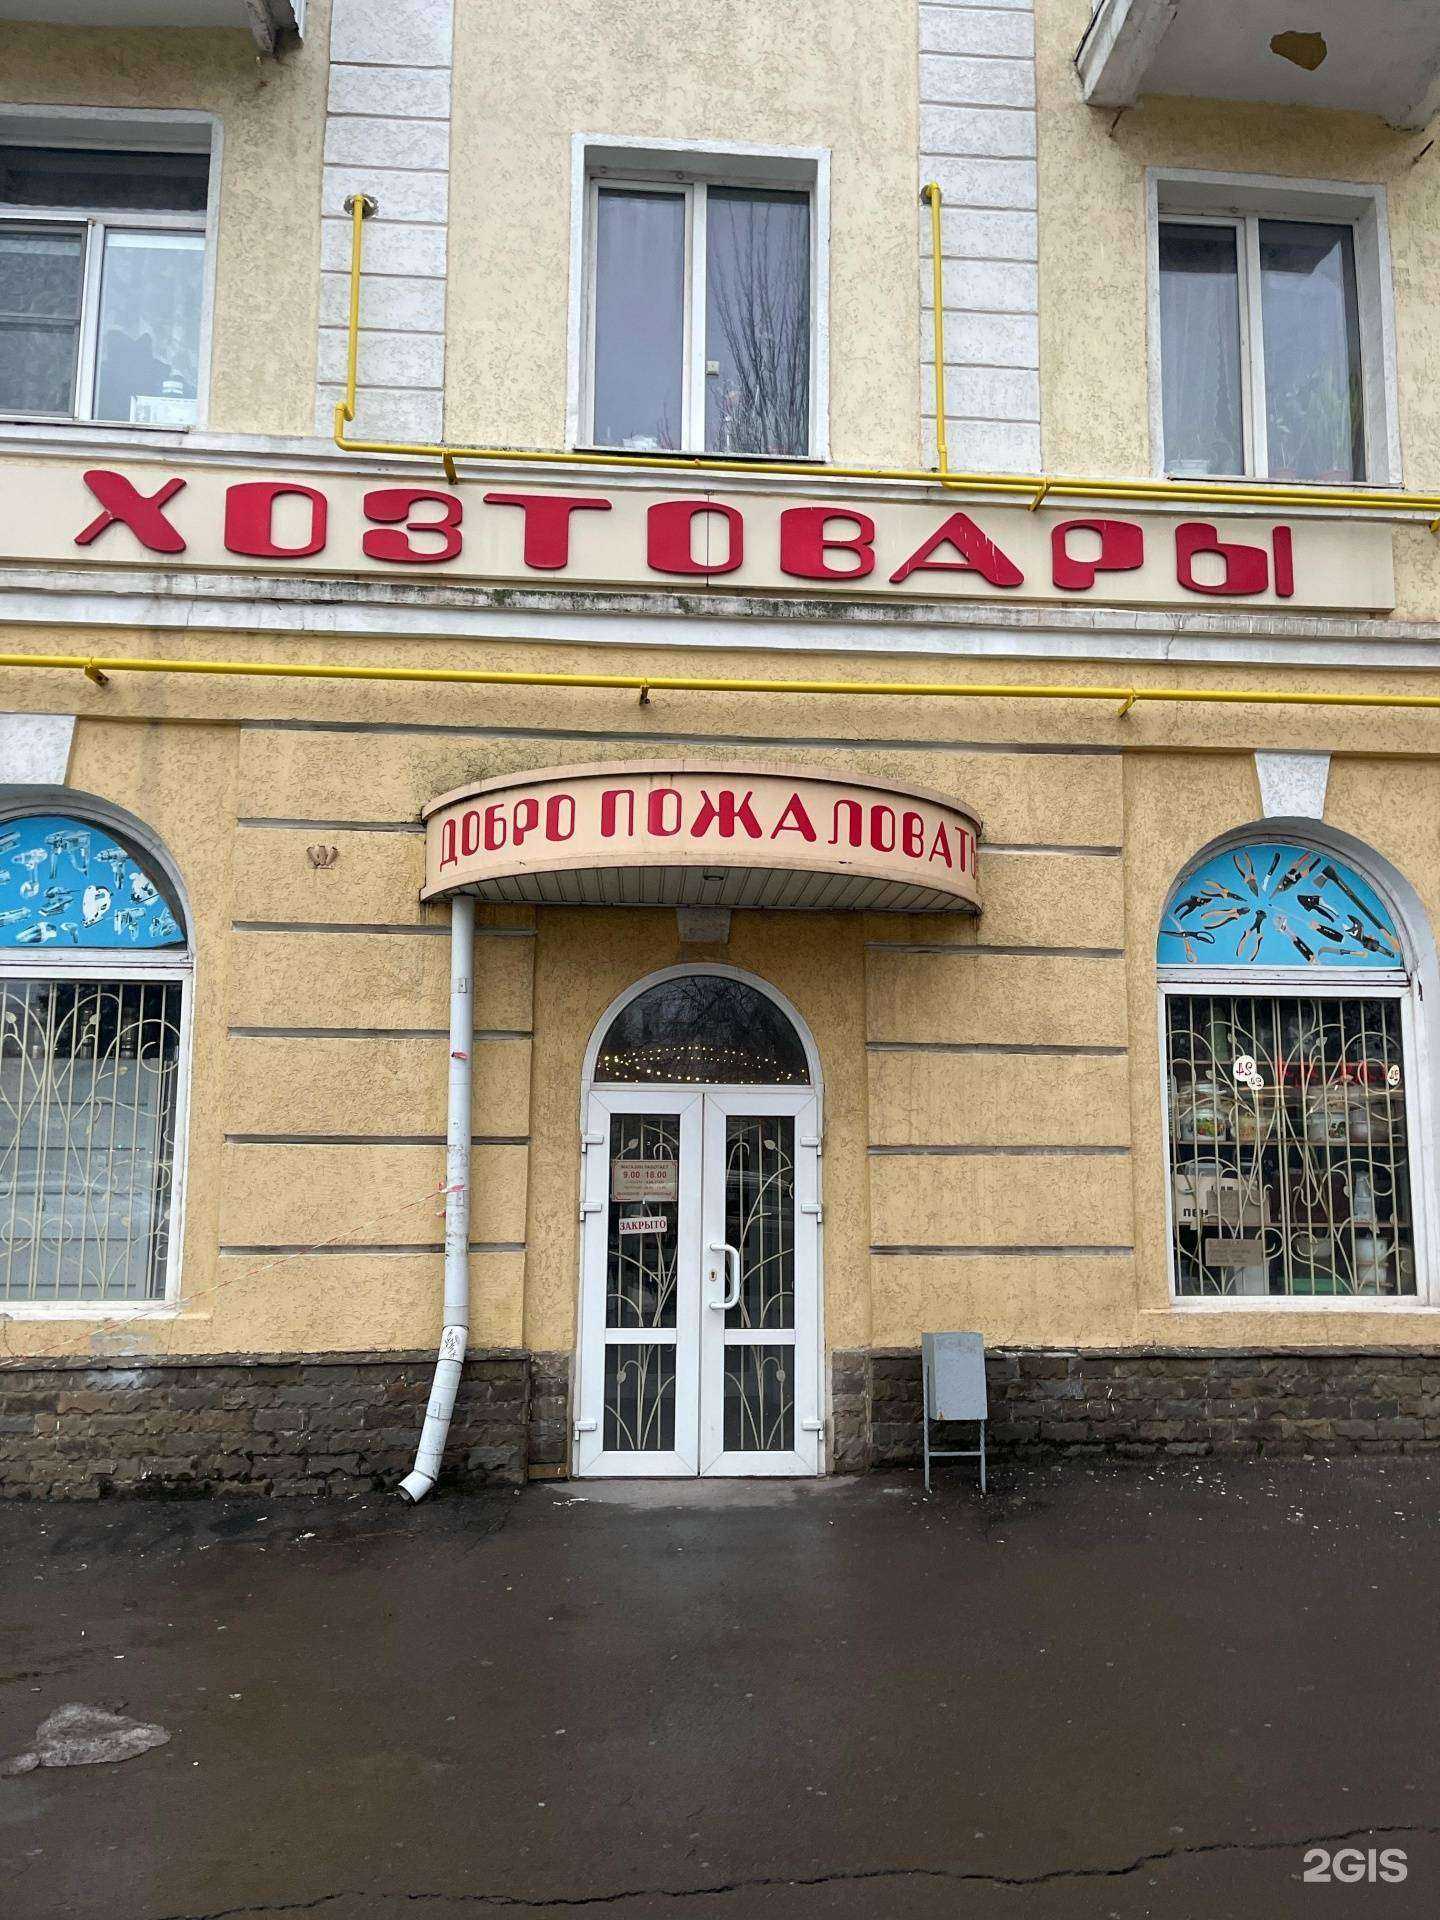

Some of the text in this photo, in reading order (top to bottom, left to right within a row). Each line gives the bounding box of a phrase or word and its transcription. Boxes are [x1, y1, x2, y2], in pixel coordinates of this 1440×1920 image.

[75, 469, 1294, 598] ХОЗТОВАРЫ
[440, 794, 576, 872] ДОБРО
[620, 1219, 666, 1230] ЗАКРЫТО
